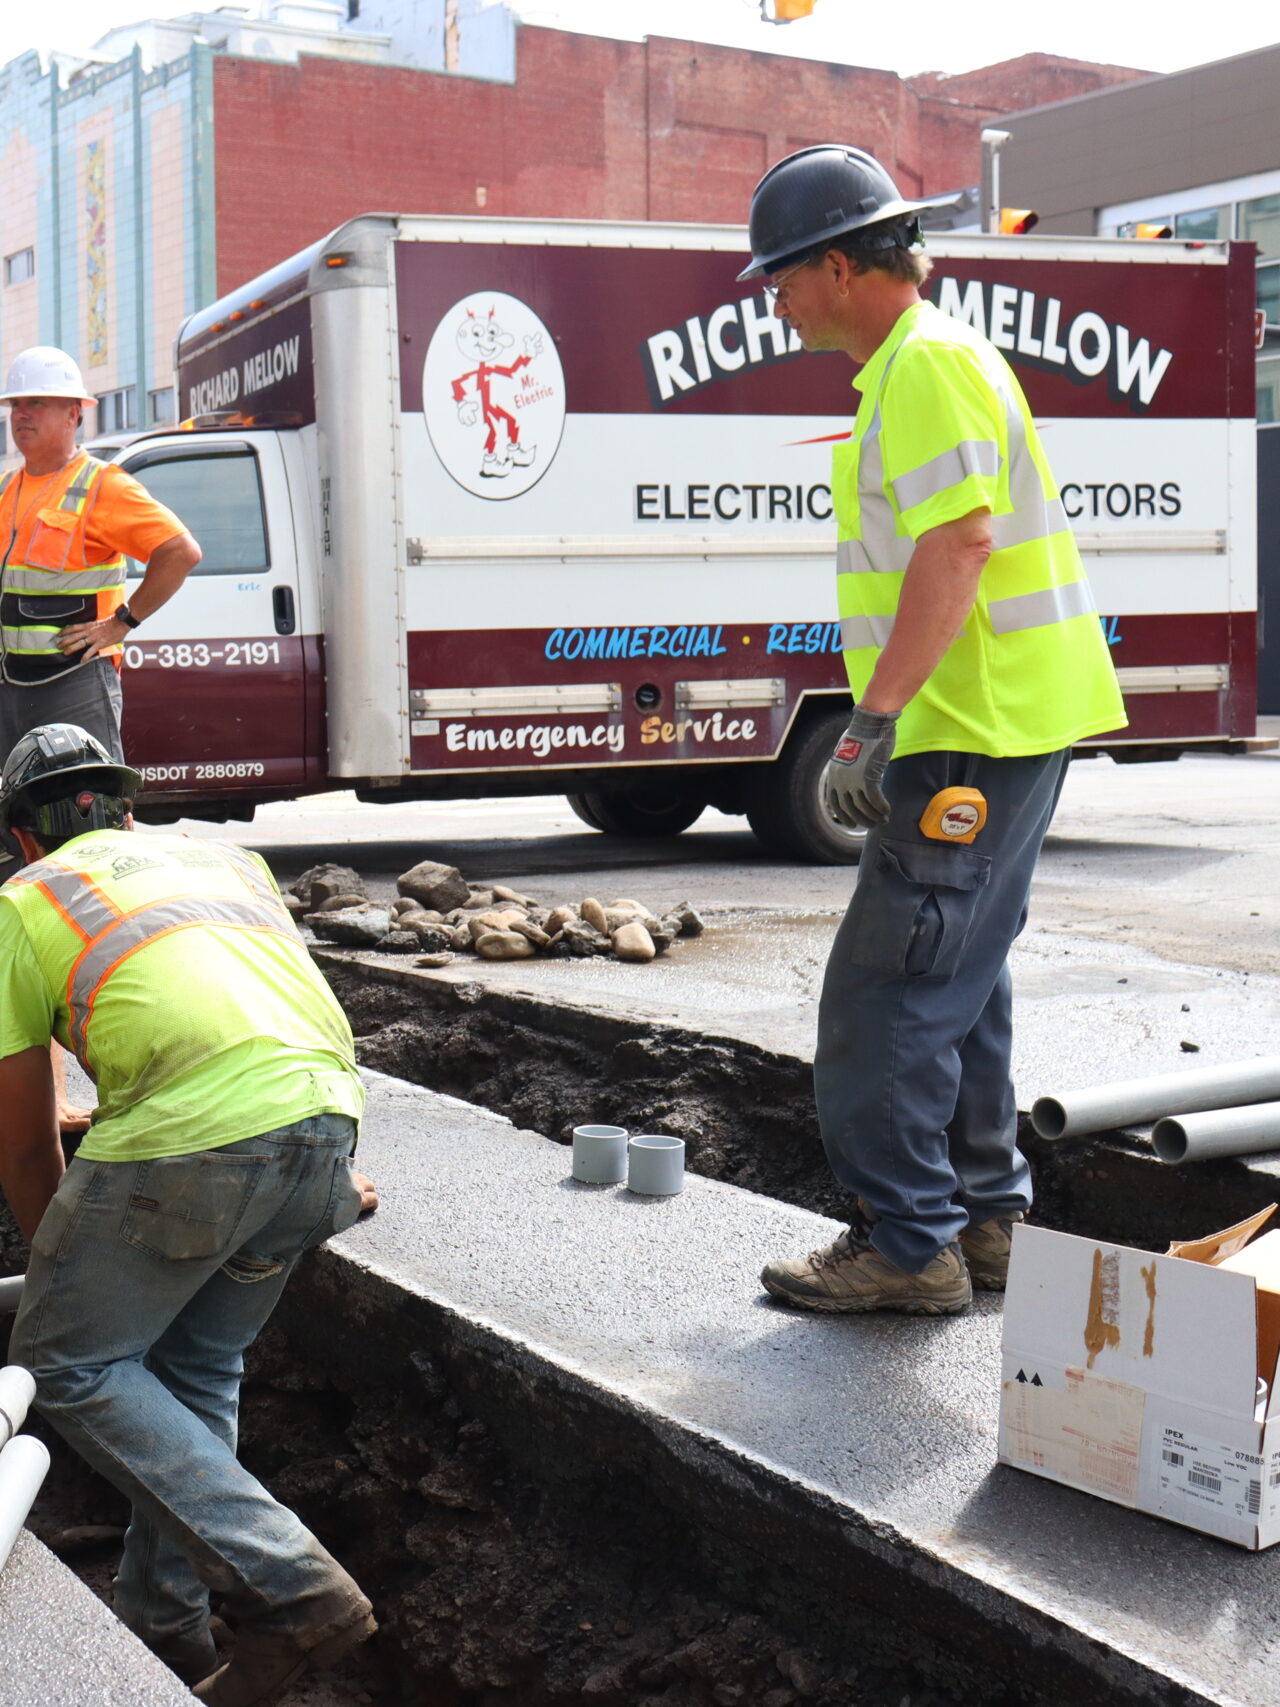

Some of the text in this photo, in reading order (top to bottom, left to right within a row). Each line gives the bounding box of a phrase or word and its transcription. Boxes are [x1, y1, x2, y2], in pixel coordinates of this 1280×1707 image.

[647, 276, 1173, 406] RICH MELLOW
[189, 335, 299, 418] RICHARD MELLOW
[521, 374, 539, 390] Mr.
[514, 386, 554, 409] Electric
[636, 483, 833, 520] ELECTRIC
[237, 582, 262, 592] Eric
[123, 641, 280, 669] 0-383-2191
[545, 625, 727, 660] COMMERCIAL
[445, 711, 757, 758] Emergency Service
[195, 762, 265, 779] 2880879
[1165, 1428, 1184, 1440] IPEX
[1174, 1440, 1198, 1452] REGULAR
